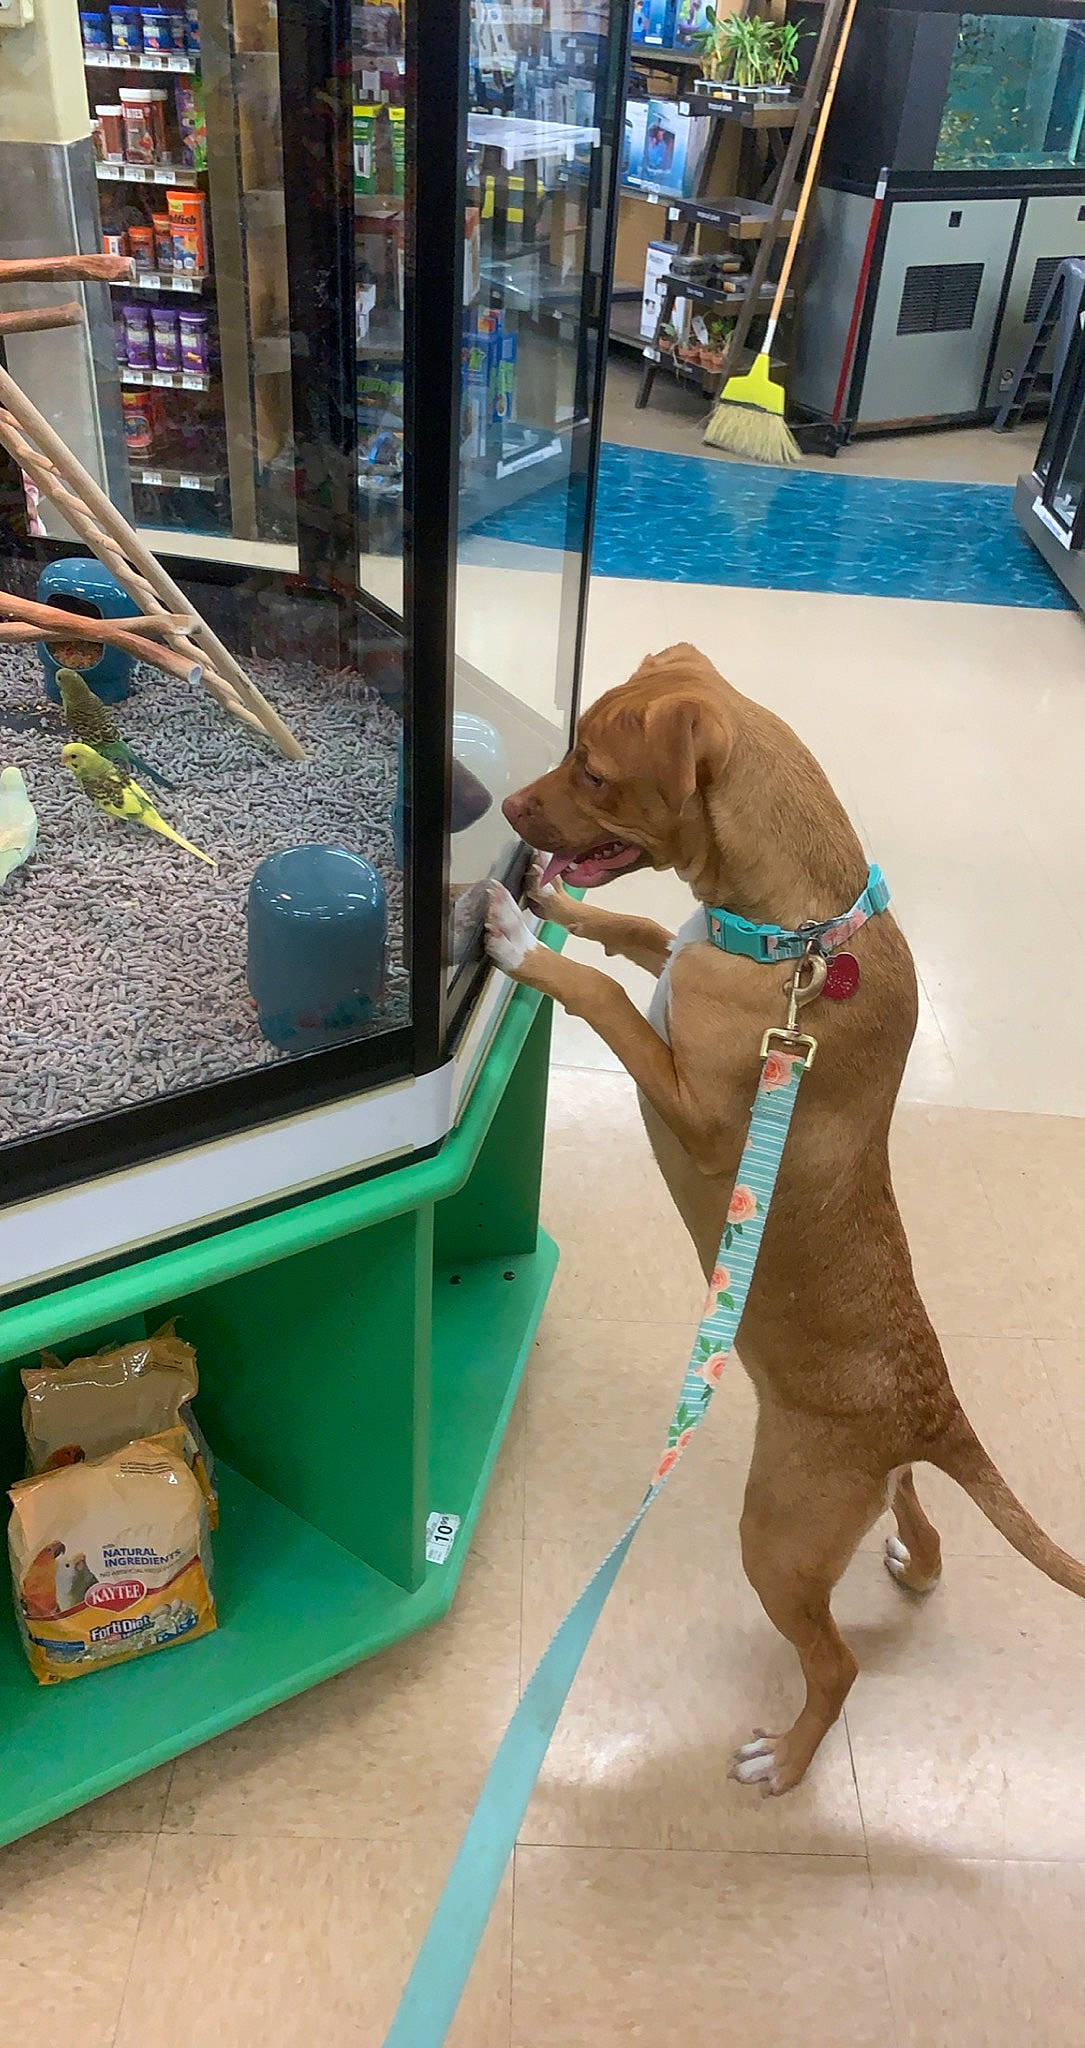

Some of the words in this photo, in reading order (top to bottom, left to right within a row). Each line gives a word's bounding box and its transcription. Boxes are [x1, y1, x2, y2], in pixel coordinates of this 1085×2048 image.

[103, 1548, 157, 1559] NATURAL
[105, 1549, 182, 1568] INGREDIENTS
[91, 1584, 142, 1605] KAYTEE
